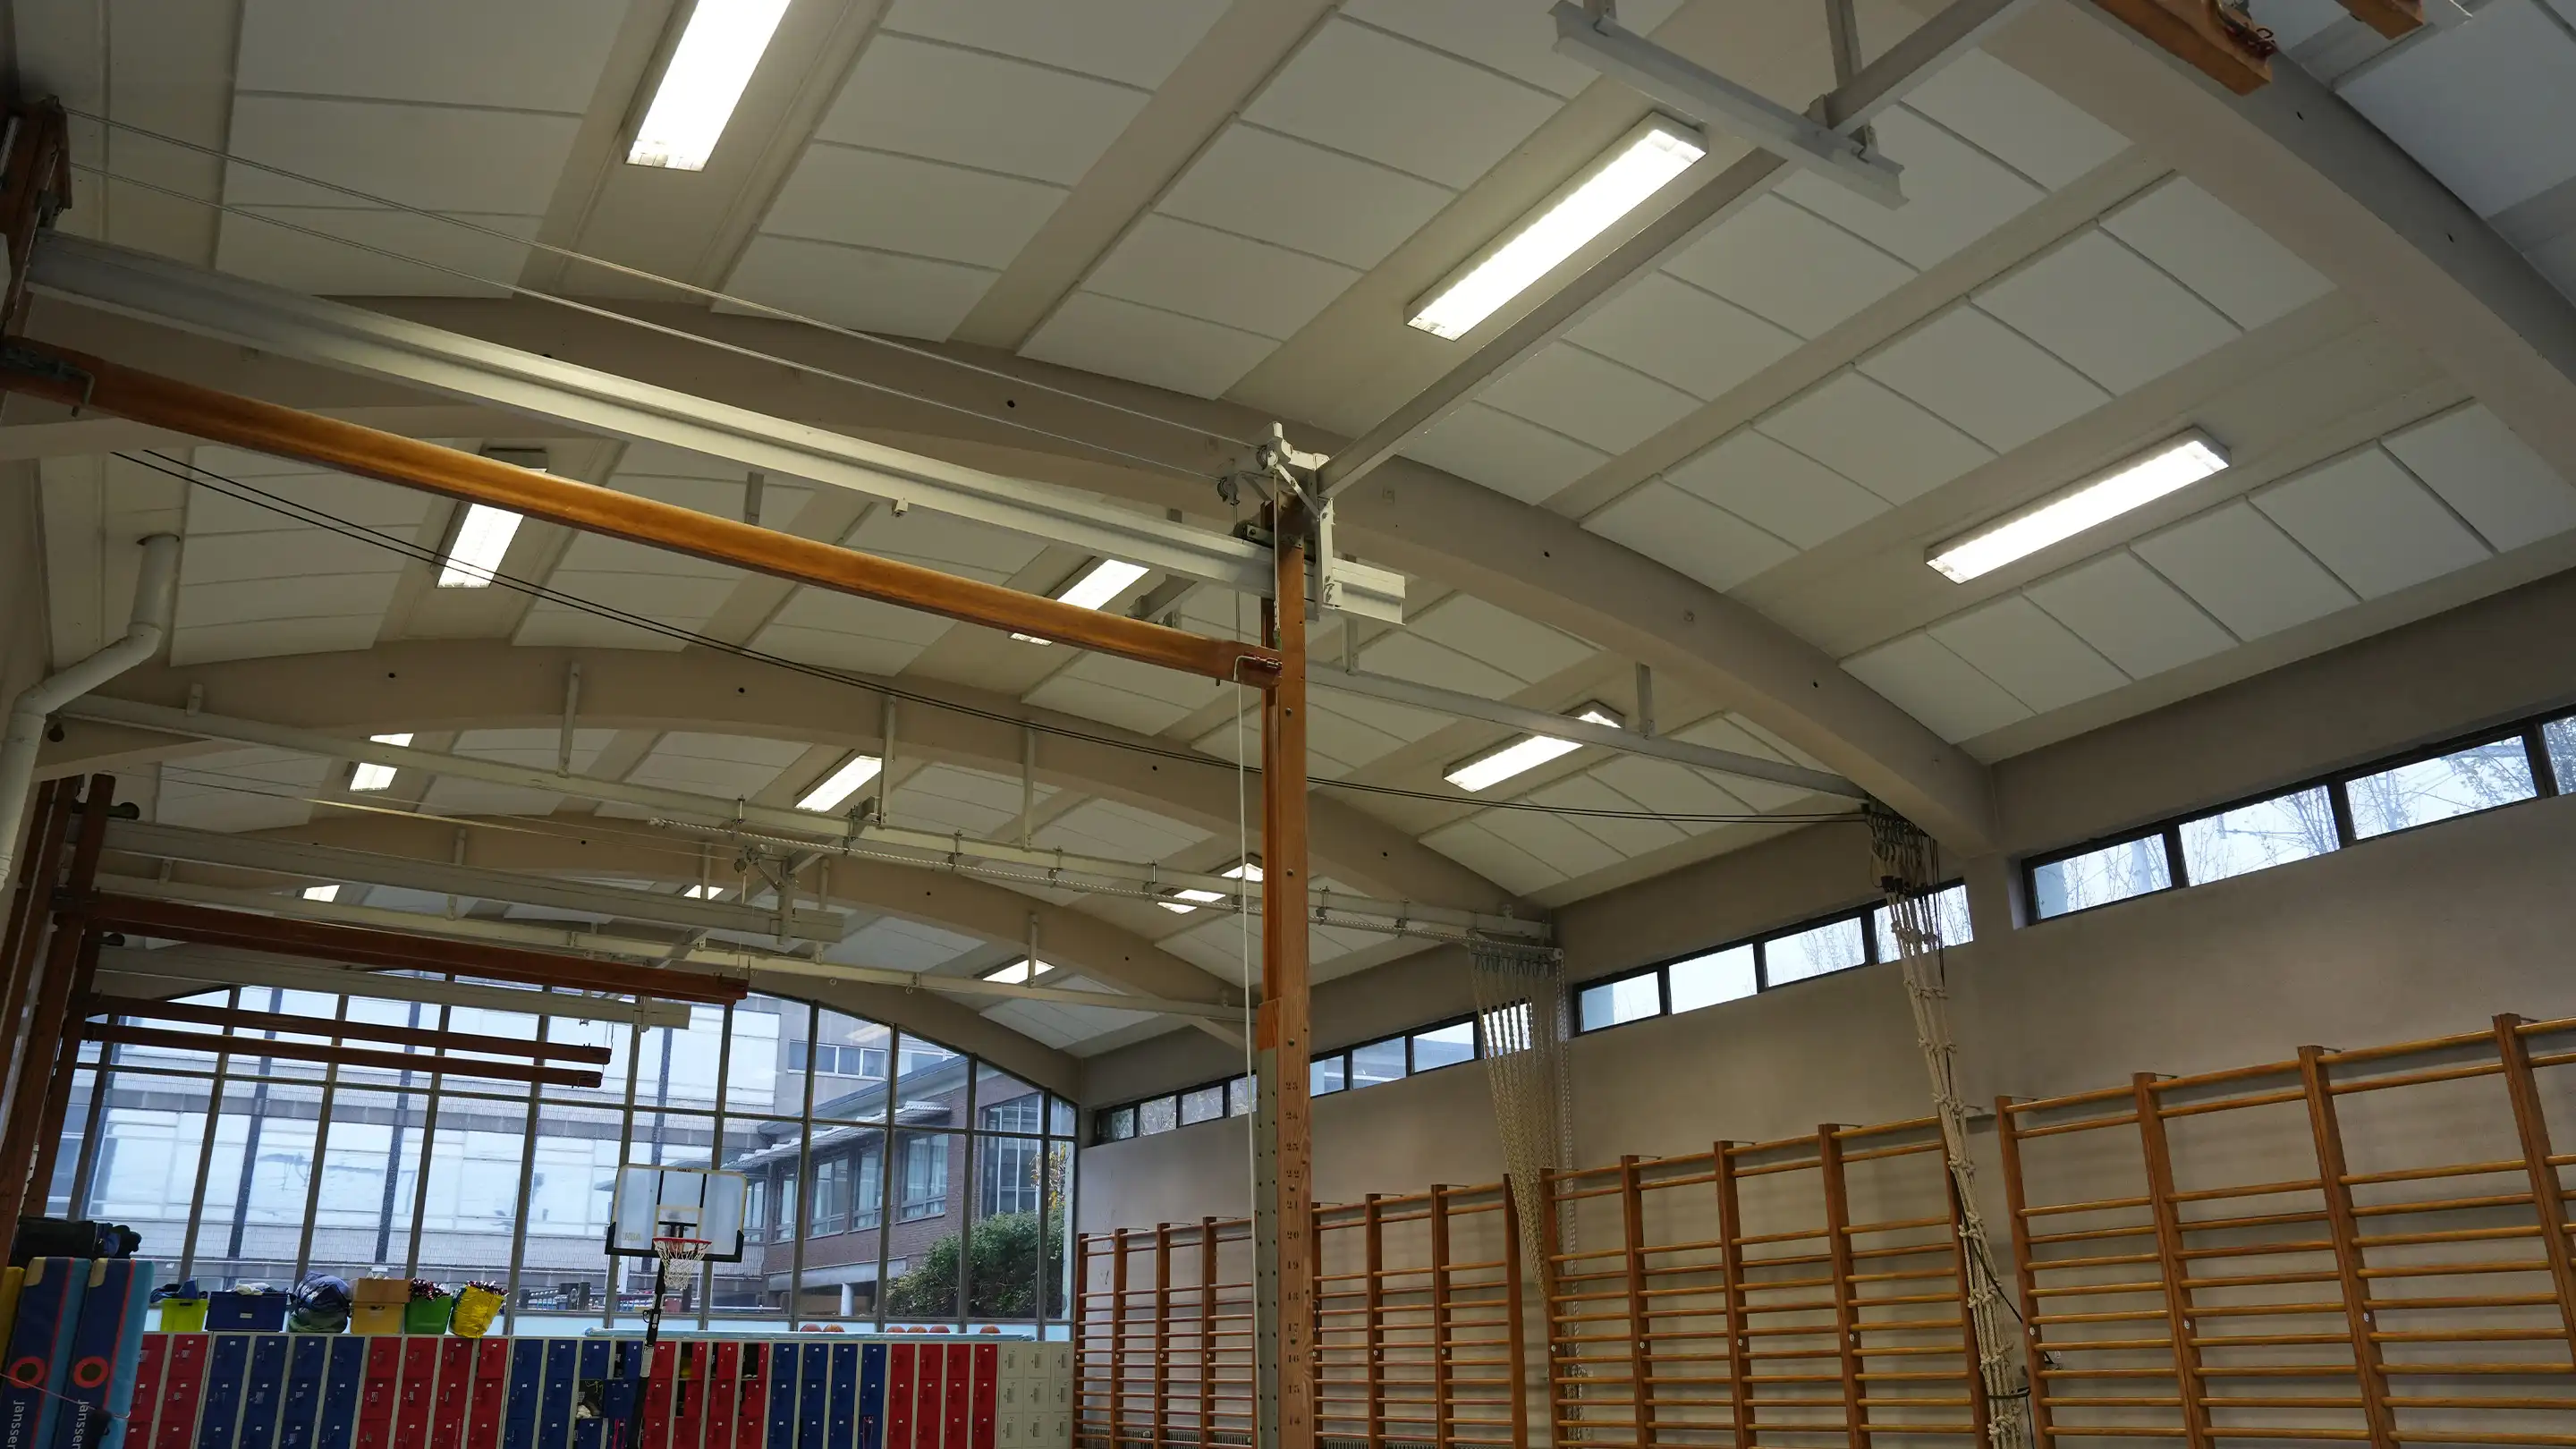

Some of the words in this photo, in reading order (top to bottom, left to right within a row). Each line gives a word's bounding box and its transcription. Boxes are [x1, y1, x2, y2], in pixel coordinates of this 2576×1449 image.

[1287, 1230, 1300, 1240] 20
[1287, 1260, 1299, 1269] 19
[1288, 1323, 1300, 1332] 17
[1288, 1354, 1300, 1363] 16
[1288, 1385, 1301, 1394] 15
